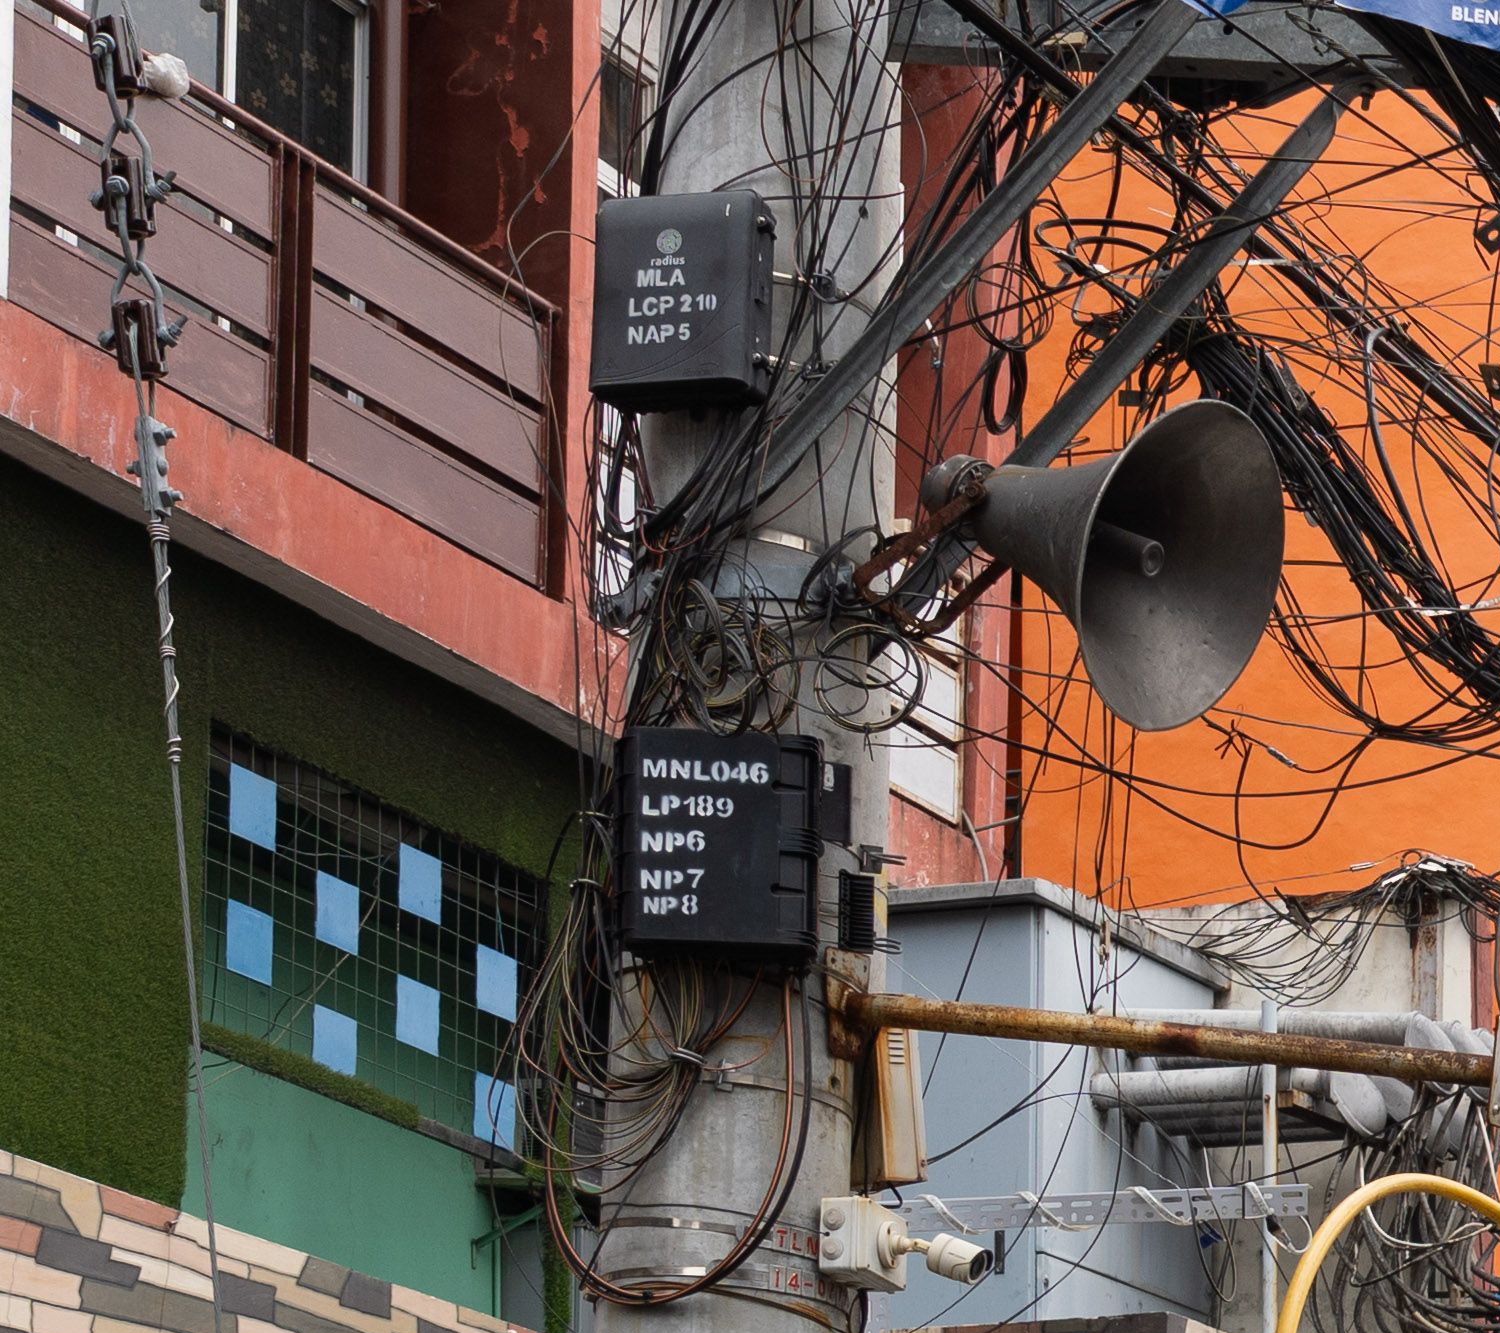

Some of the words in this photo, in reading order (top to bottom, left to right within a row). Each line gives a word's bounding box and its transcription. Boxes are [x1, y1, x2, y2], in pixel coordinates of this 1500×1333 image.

[650, 255, 686, 266] radius
[637, 268, 686, 288] MLA
[628, 295, 675, 318] LCP
[680, 293, 717, 313] 210
[627, 324, 674, 345] NAP
[677, 322, 690, 342] 5
[643, 758, 769, 784] MNL046
[641, 795, 735, 818] LP189
[640, 830, 706, 853] NP6
